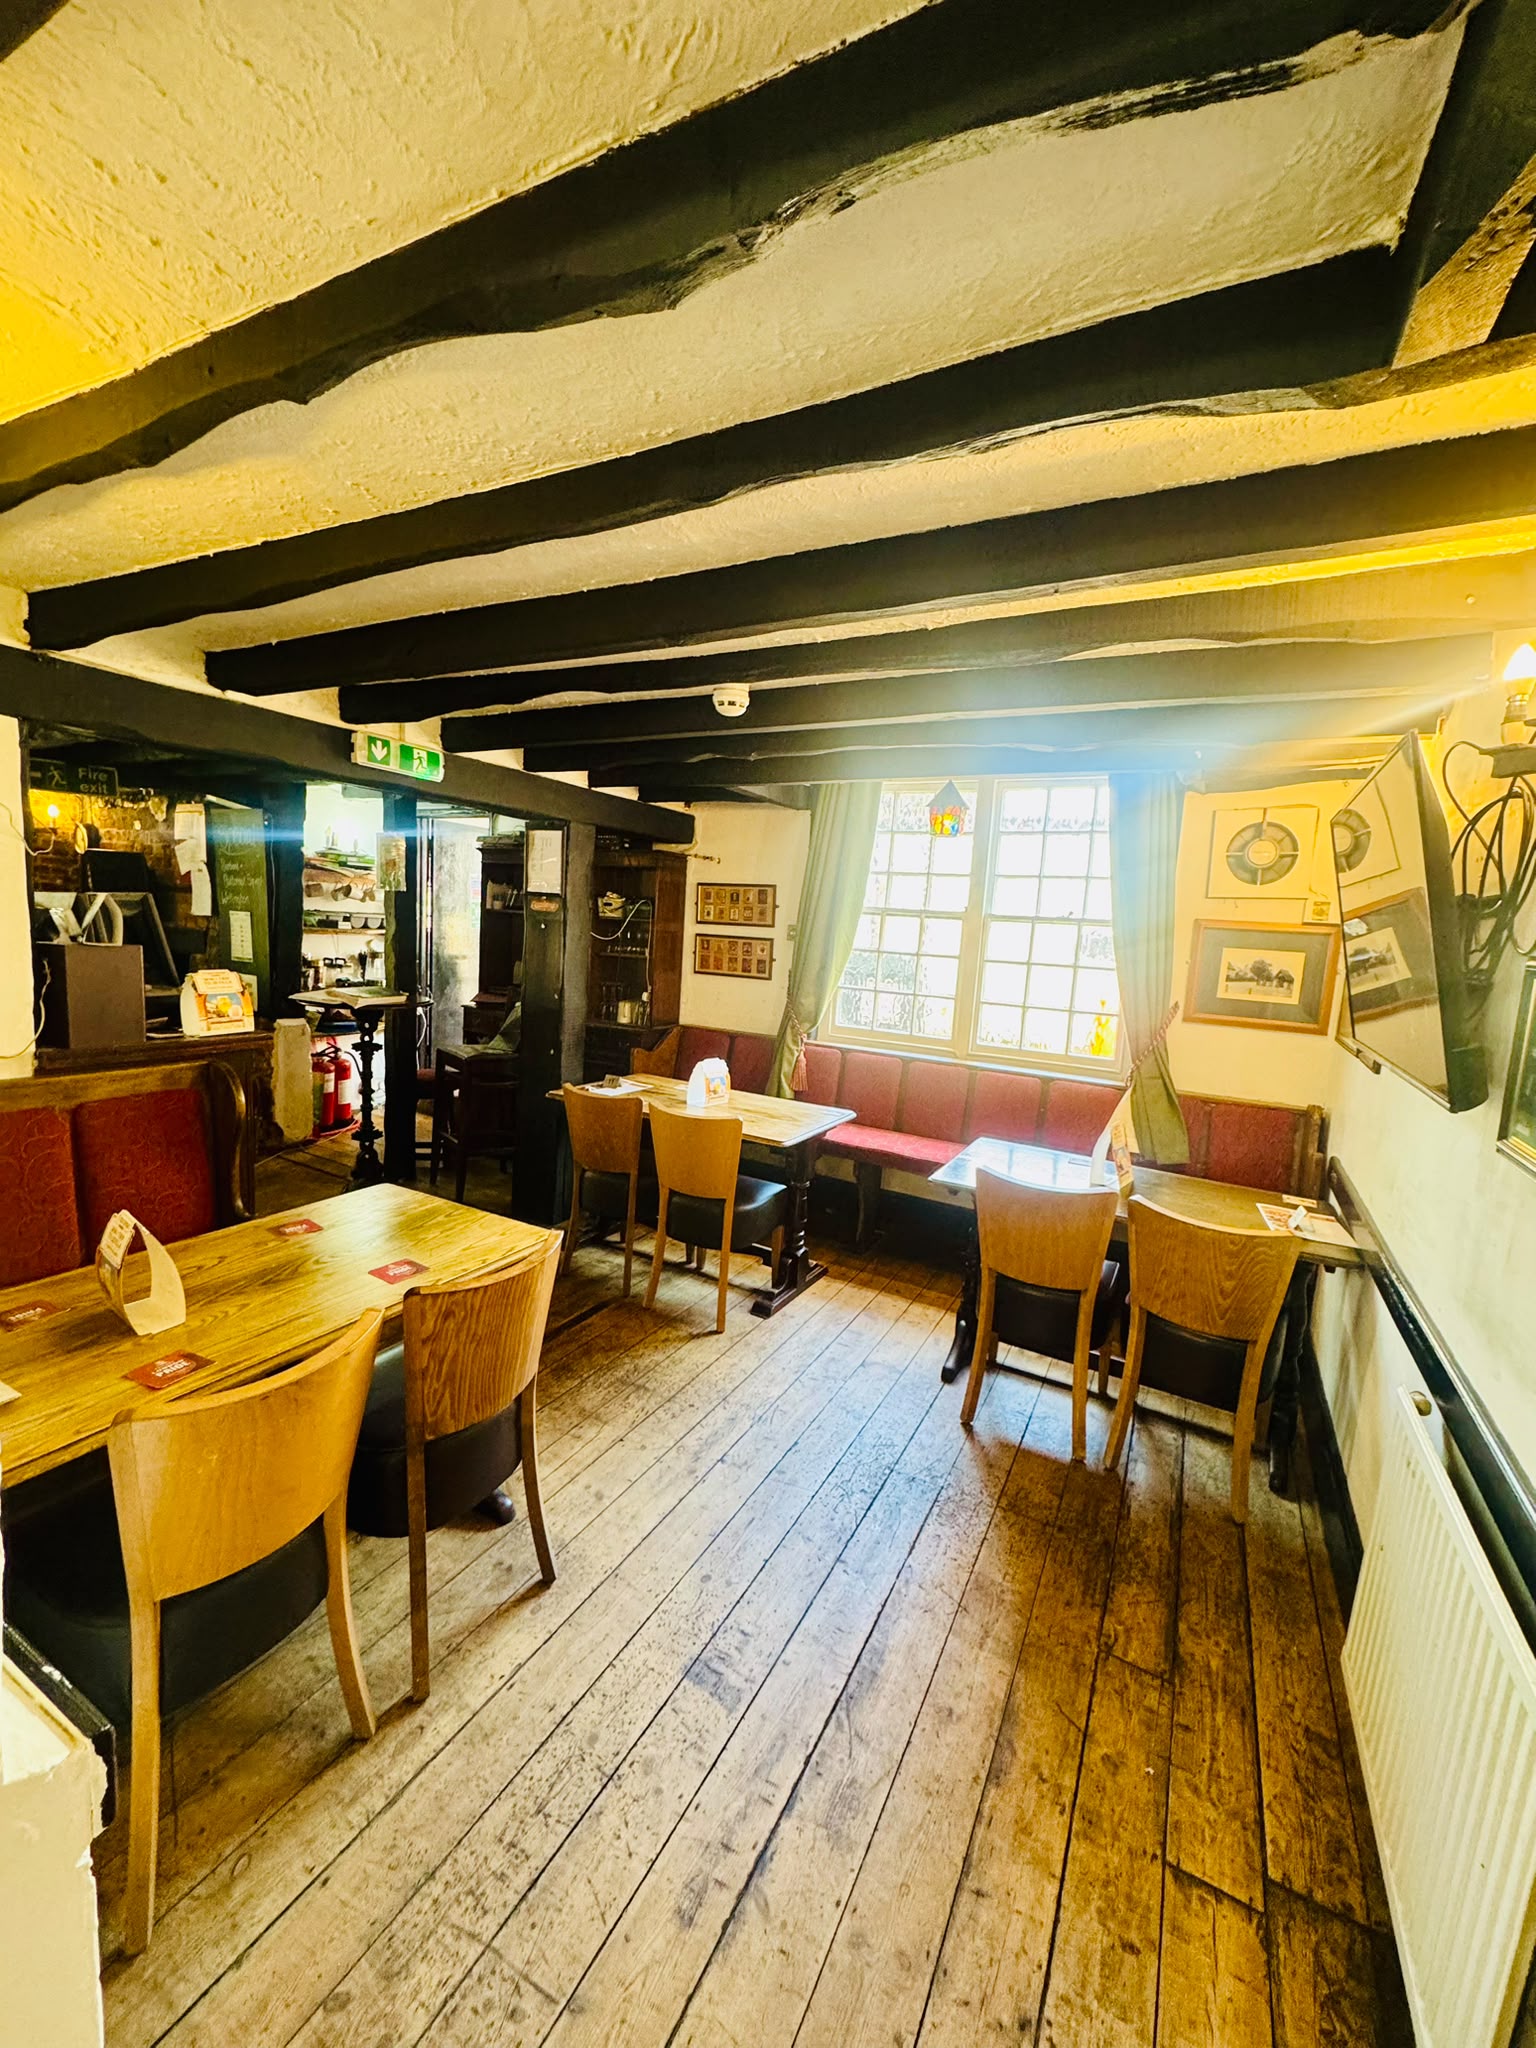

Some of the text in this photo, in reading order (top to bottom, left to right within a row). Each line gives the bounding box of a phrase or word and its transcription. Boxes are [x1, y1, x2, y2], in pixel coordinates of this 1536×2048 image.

[78, 767, 108, 780] Fire
[80, 783, 108, 795] exit
[154, 1361, 192, 1377] PRIDE
